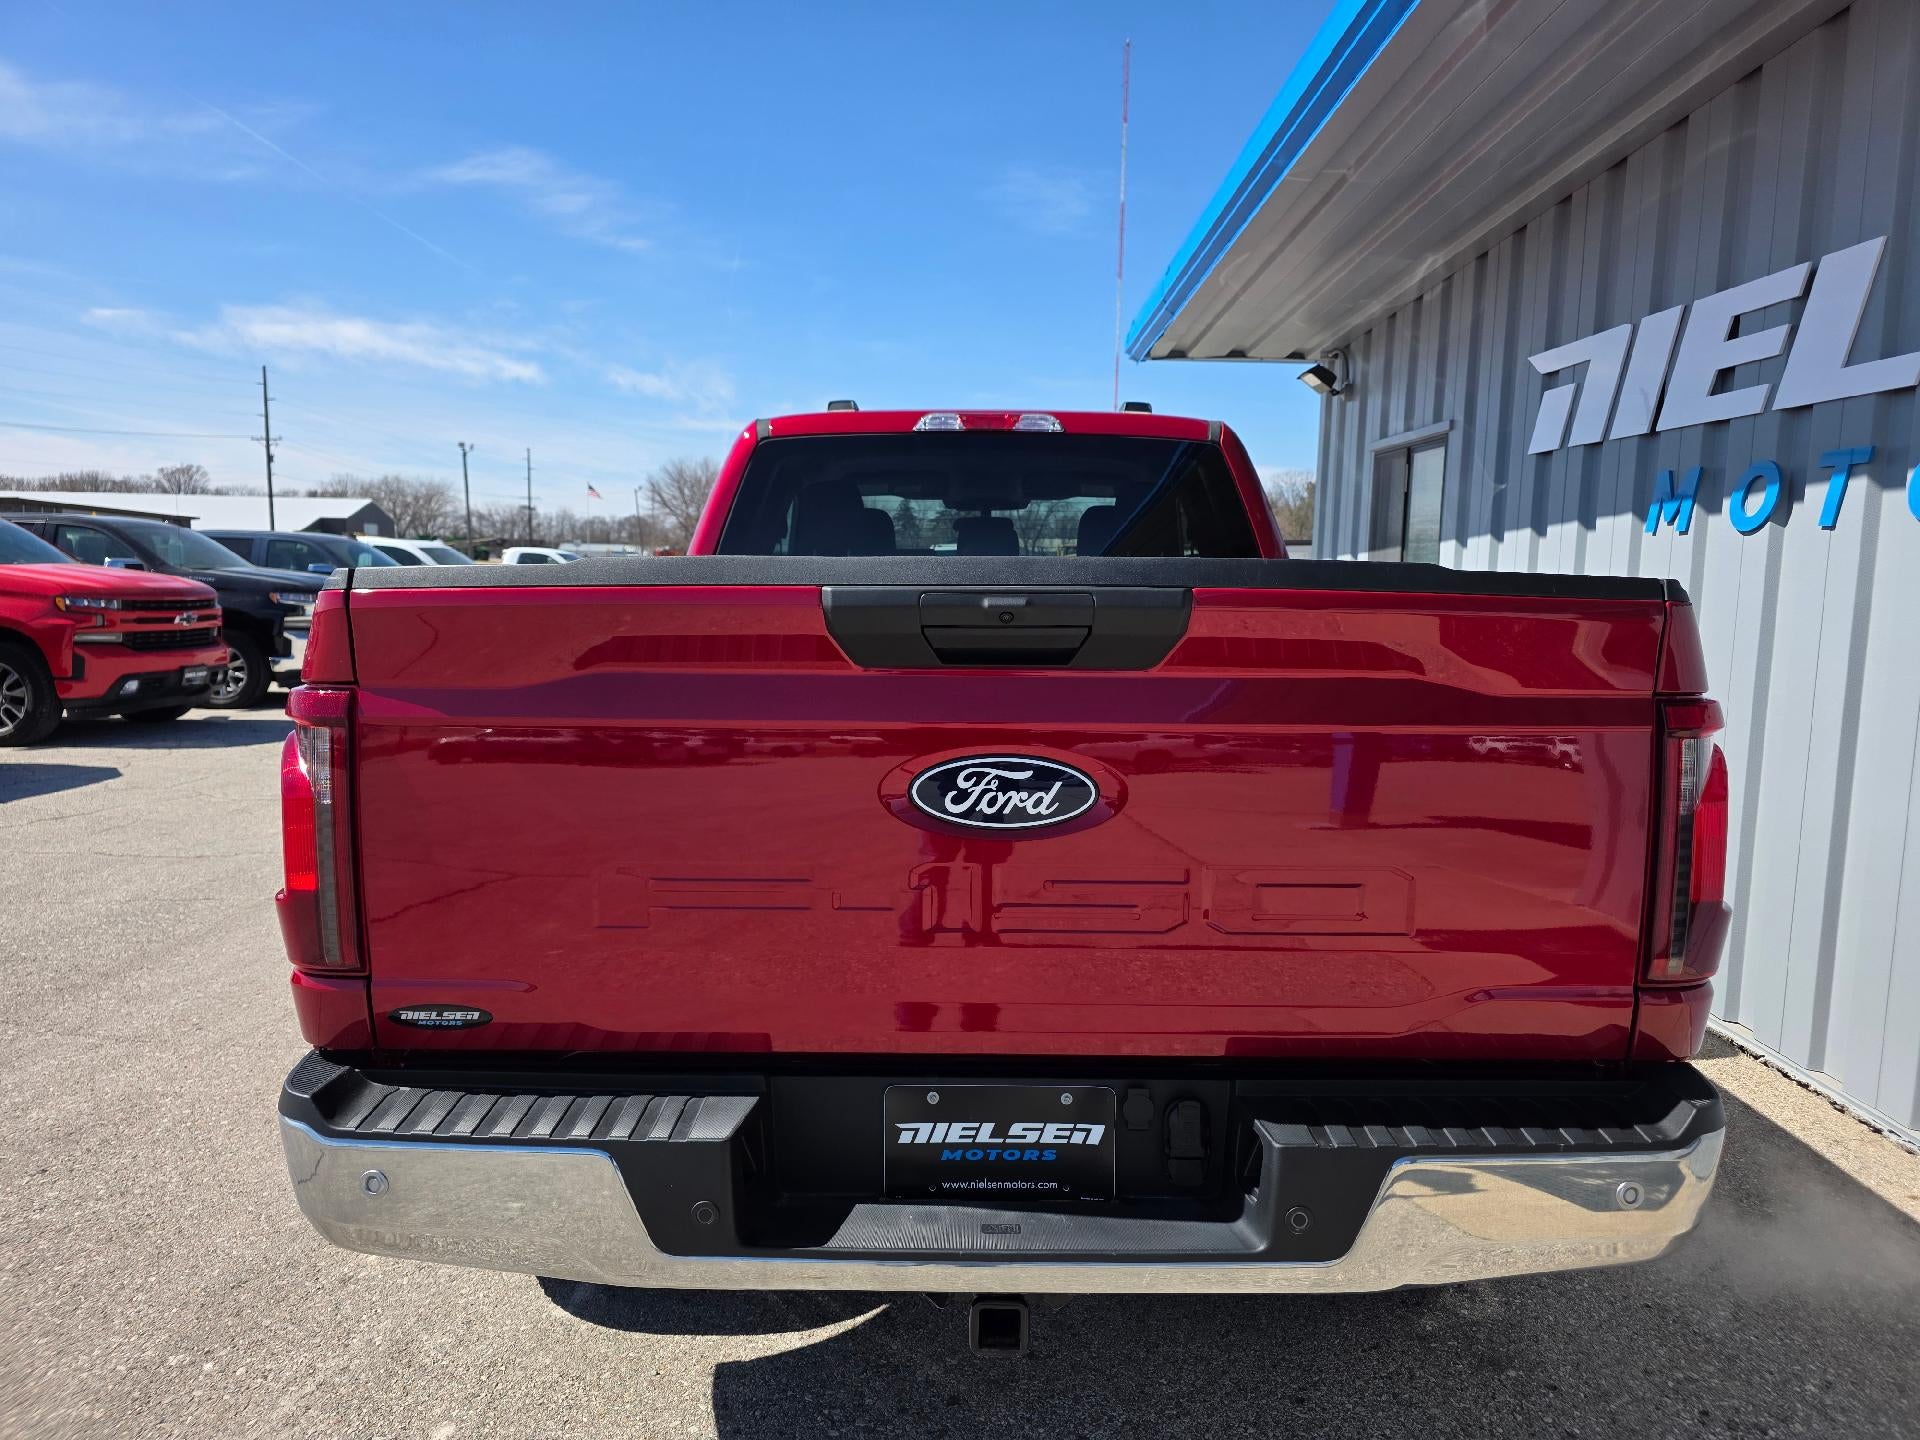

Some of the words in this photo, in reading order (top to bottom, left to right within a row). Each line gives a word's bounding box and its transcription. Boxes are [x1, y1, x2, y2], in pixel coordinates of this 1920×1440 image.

[1645, 445, 1920, 535] MOT
[944, 767, 1063, 815] Ford
[398, 1010, 480, 1020] NIELSEN
[894, 1122, 1106, 1146] NIELSEN
[940, 1149, 1057, 1161] MOTORS
[941, 1178, 1058, 1189] www.nielsenmotors.com
